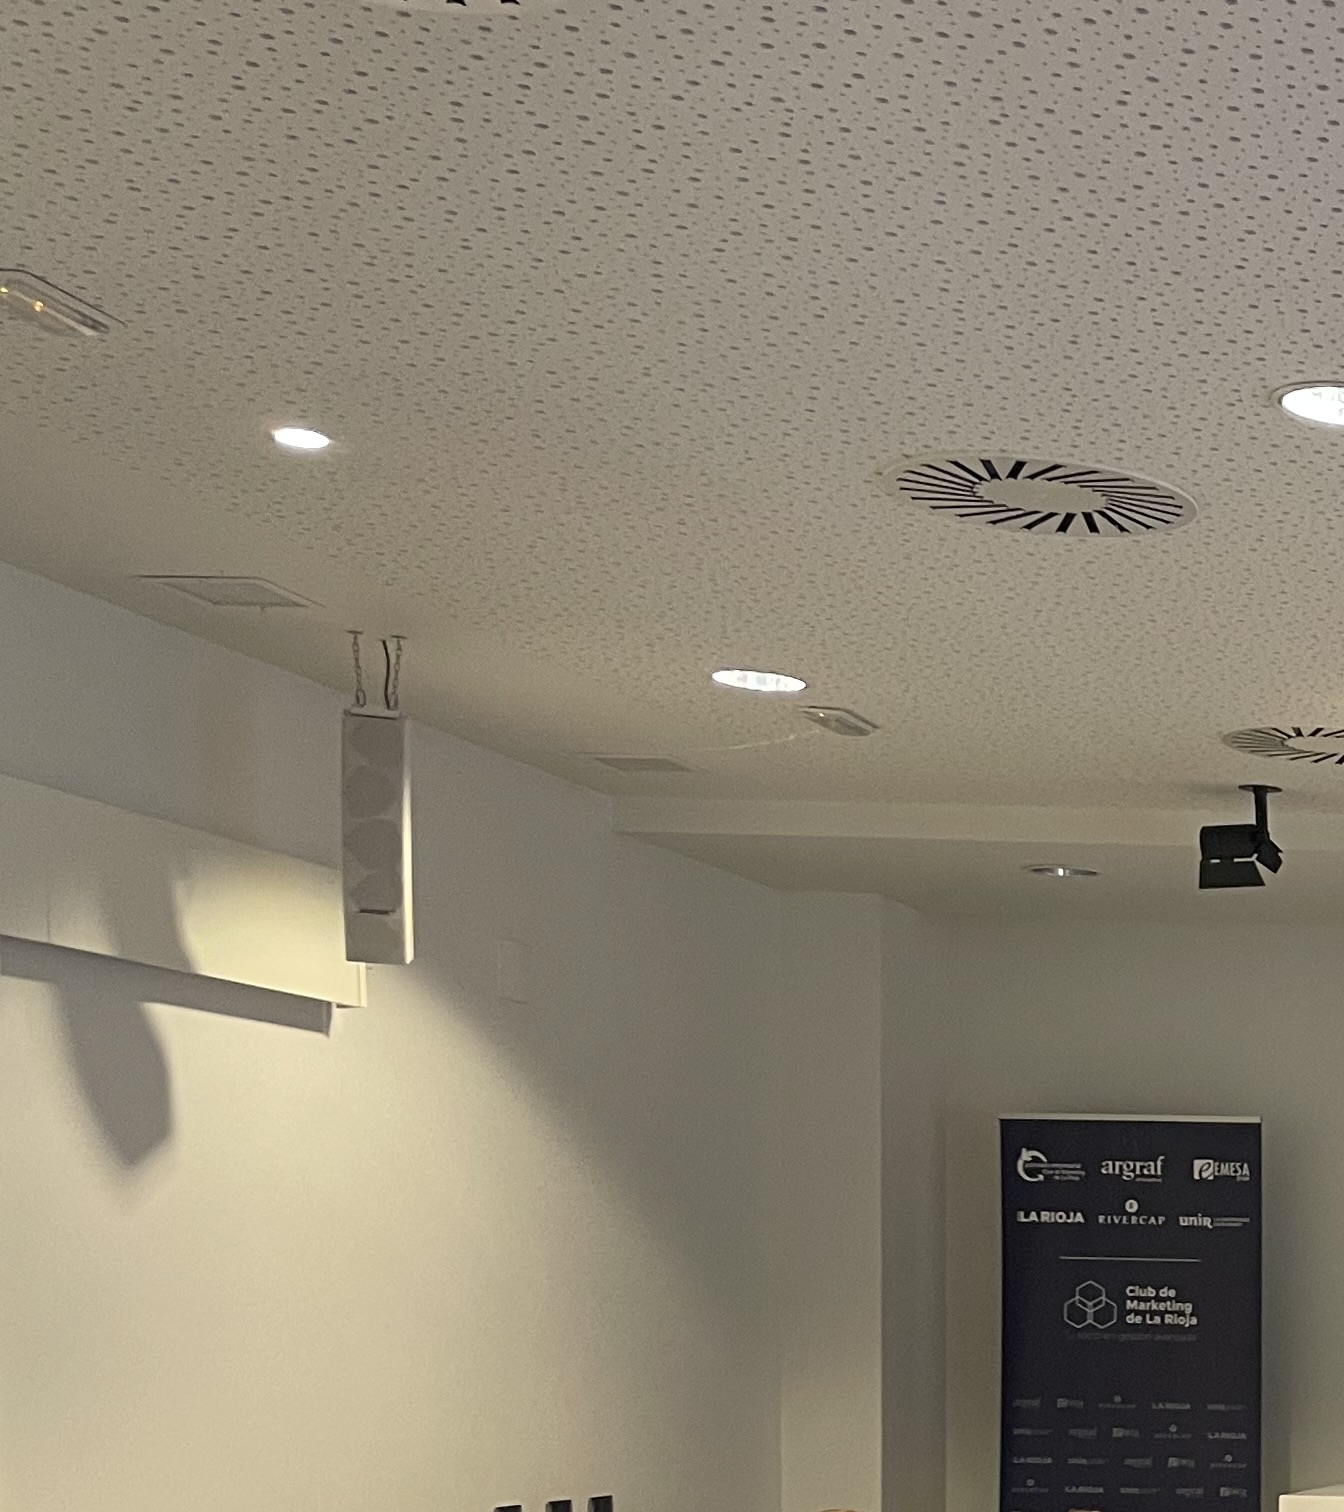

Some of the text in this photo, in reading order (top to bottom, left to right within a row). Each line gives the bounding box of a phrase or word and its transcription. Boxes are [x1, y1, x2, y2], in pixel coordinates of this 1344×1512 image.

[1101, 1155, 1165, 1181] argraf
[1214, 1162, 1250, 1176] EMESA
[1018, 1211, 1085, 1223] LA RIOJA
[1125, 1285, 1176, 1298] Club de
[1125, 1299, 1193, 1314] Marketing
[1125, 1313, 1198, 1328] de La Rioja
